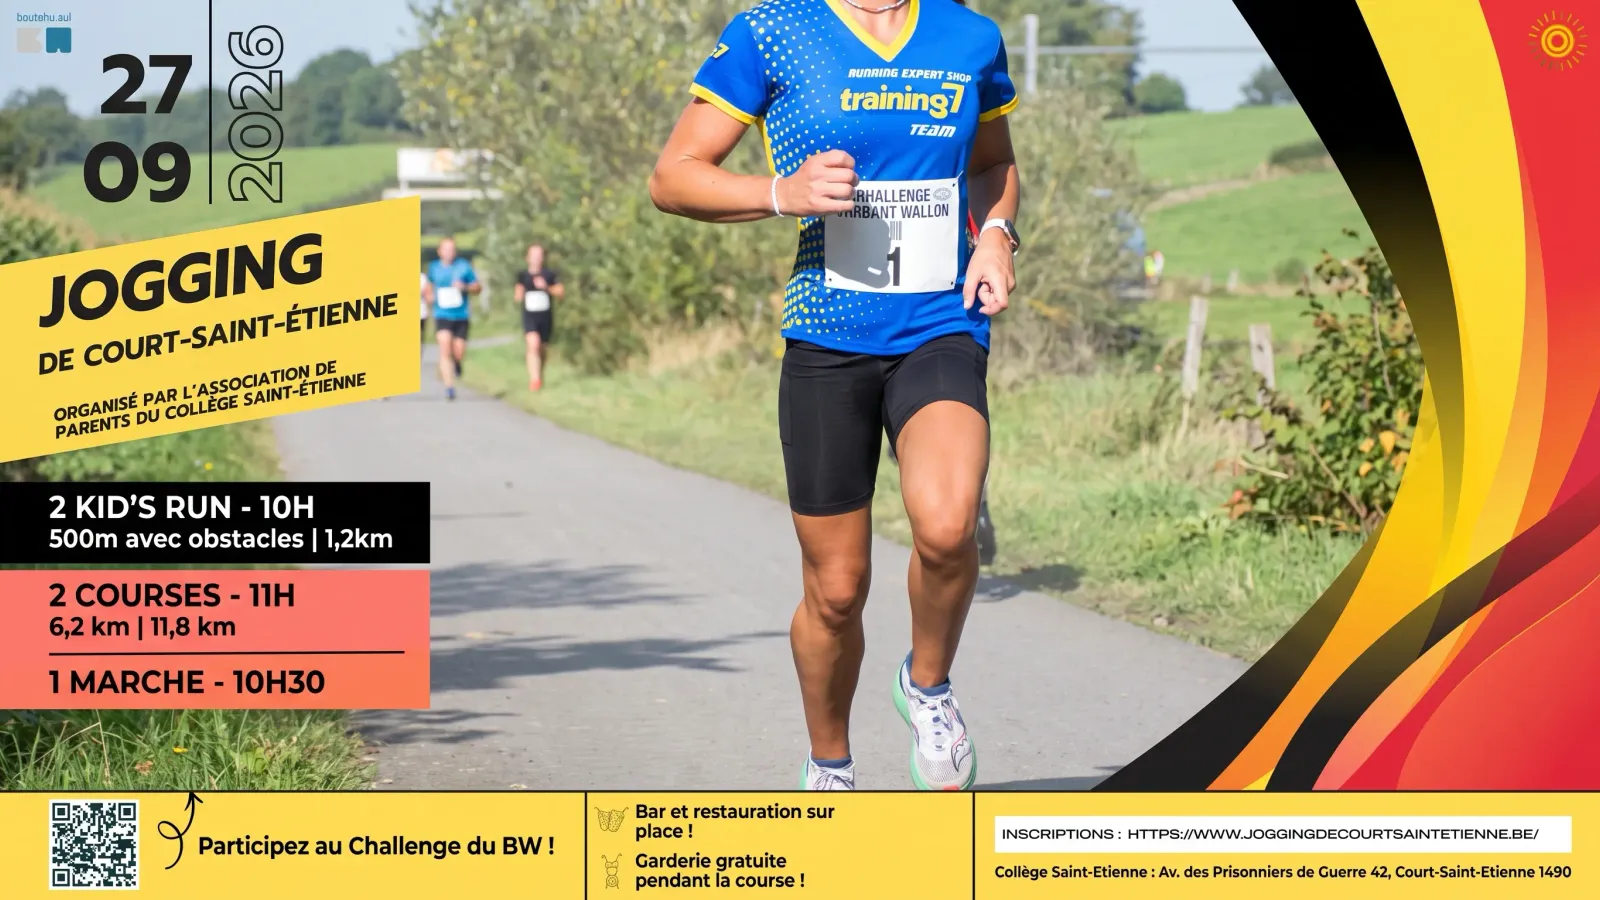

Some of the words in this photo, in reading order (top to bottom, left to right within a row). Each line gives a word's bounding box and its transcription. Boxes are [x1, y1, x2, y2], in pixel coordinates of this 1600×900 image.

[848, 68, 899, 78] RUNNING
[901, 68, 944, 80] EXPERT
[946, 71, 972, 83] SHOP
[909, 123, 957, 138] TEAM
[853, 188, 931, 203] RHALLENGE
[900, 203, 949, 219] WALLON
